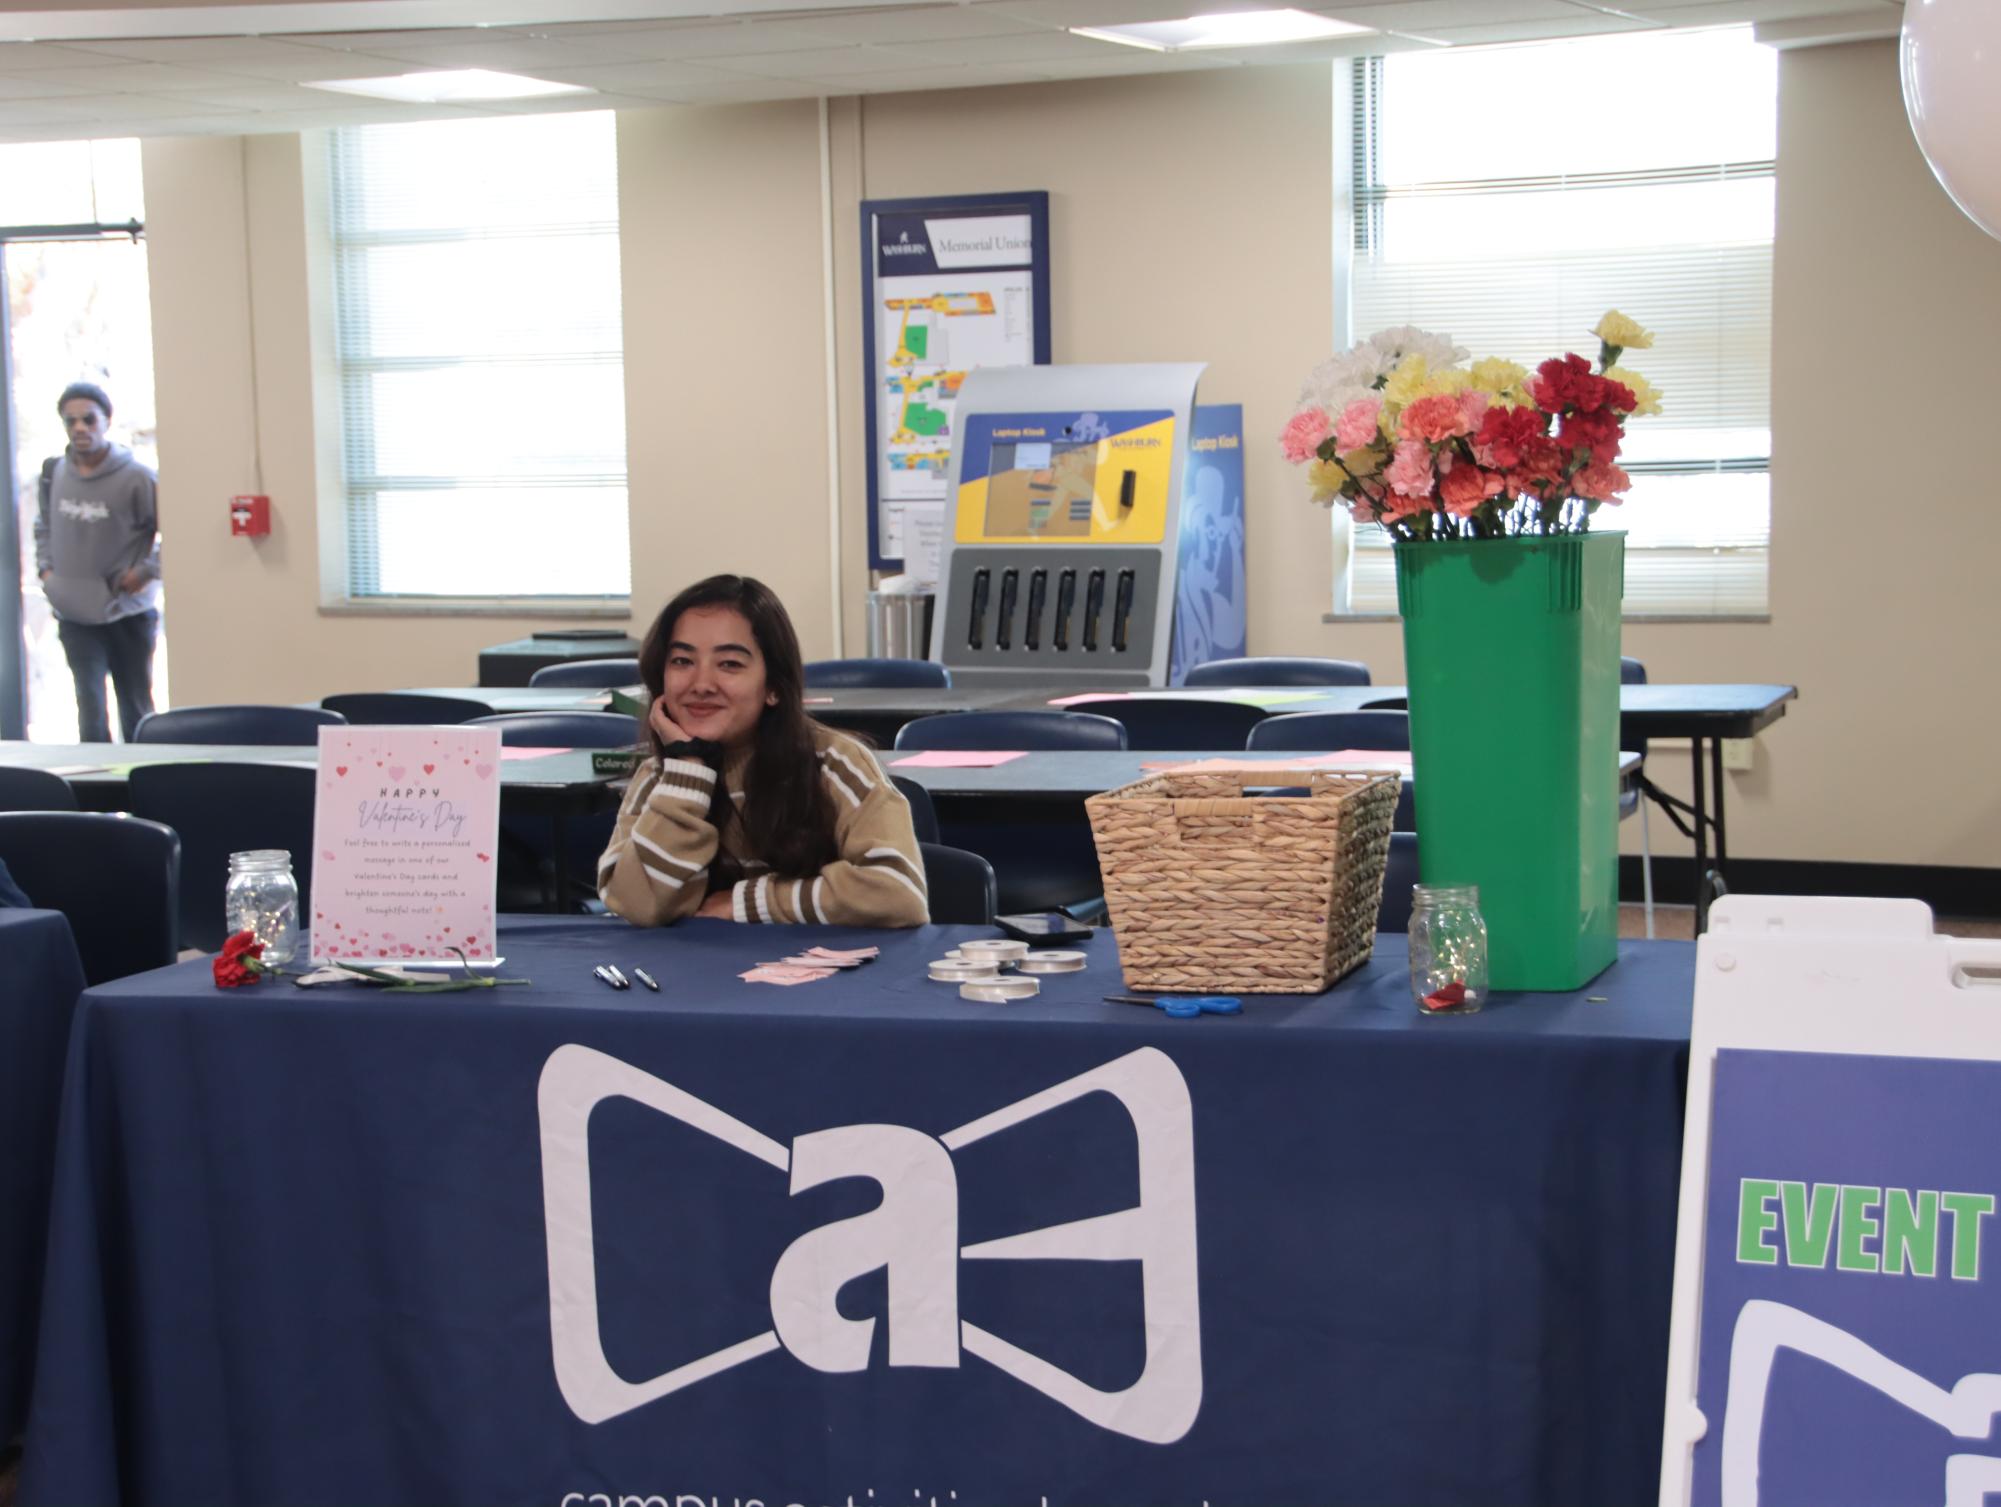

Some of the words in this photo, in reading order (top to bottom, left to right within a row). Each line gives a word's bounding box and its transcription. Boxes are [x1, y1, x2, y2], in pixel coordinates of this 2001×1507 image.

[939, 237, 992, 253] Memorial
[380, 788, 440, 798] HAPPY
[359, 800, 429, 832] Valentine's
[434, 800, 466, 838] Day
[344, 838, 360, 847] Feel
[362, 838, 378, 848] free
[381, 839, 389, 847] to
[392, 839, 411, 847] write
[364, 857, 396, 866] message
[398, 856, 406, 864] in
[425, 855, 435, 865] of
[353, 873, 397, 881] Valentine's
[399, 873, 415, 883] Day
[418, 873, 440, 881] cards
[442, 873, 458, 881] and
[345, 889, 379, 899] brighten
[381, 889, 420, 897] someone's
[423, 889, 438, 900] day
[440, 889, 458, 897] with
[365, 905, 409, 916] thoughtful
[411, 906, 432, 914] note!
[1735, 1177, 1996, 1282] EVENT
